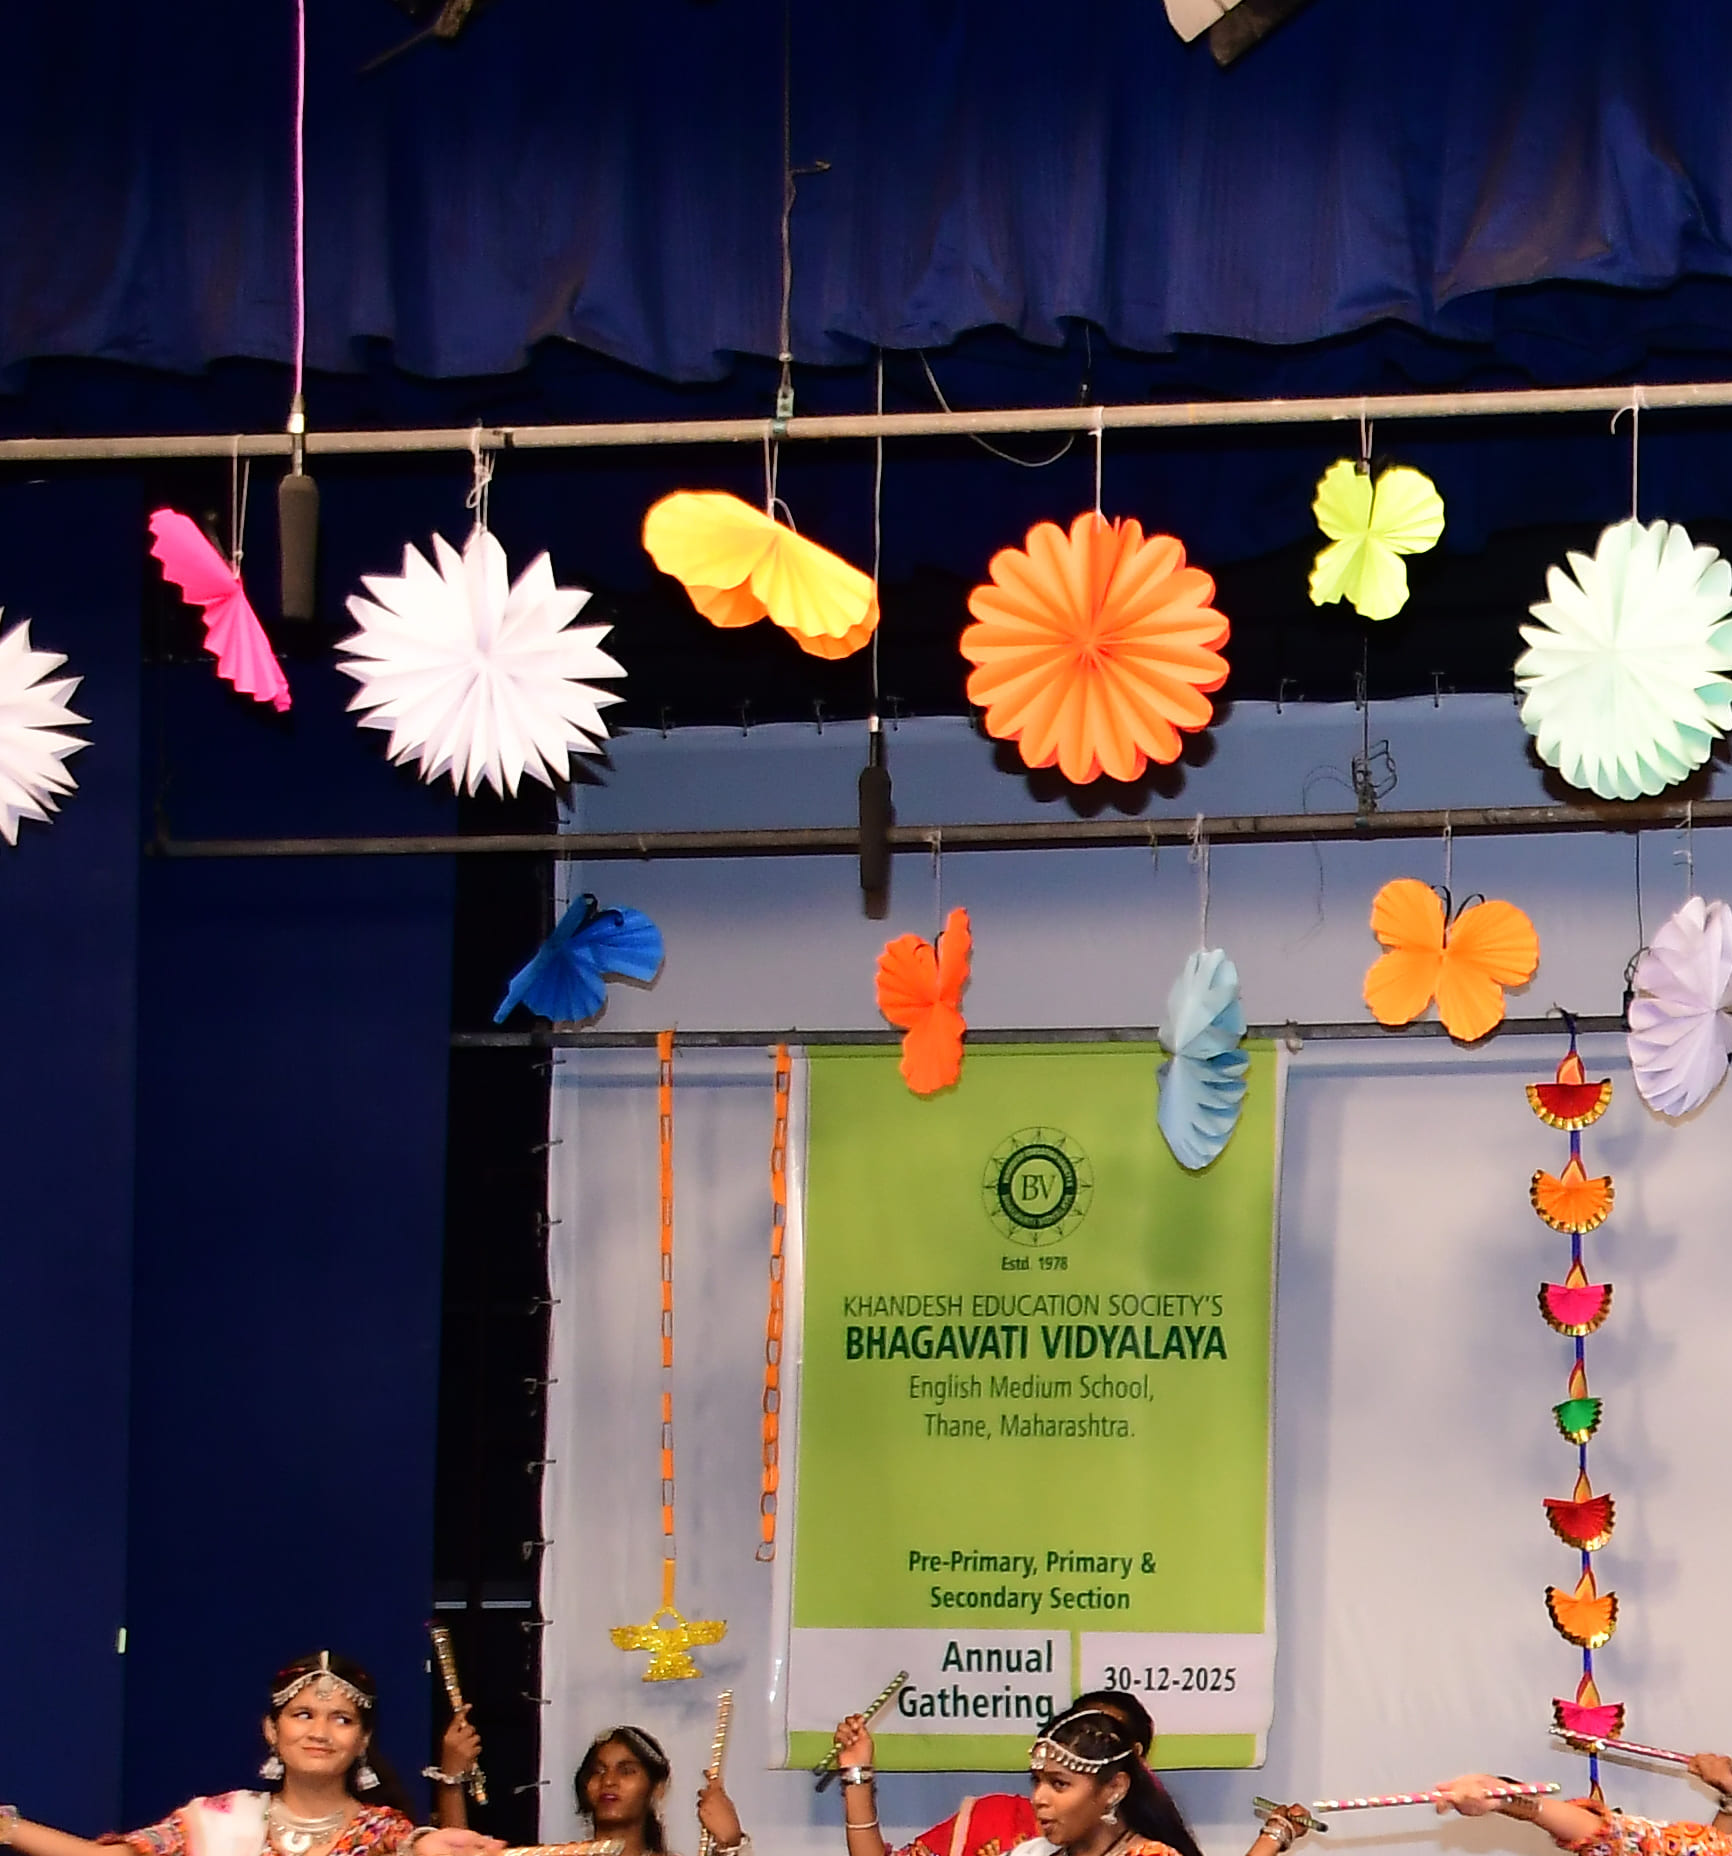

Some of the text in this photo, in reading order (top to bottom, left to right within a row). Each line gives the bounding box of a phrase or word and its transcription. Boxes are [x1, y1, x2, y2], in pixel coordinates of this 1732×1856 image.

[1021, 1174, 1057, 1201] BV
[844, 1295, 962, 1317] KHANDESH
[972, 1295, 1099, 1317] EDUCATION
[846, 1325, 1228, 1360] BHAGAVATI VIDYALAYA
[909, 1374, 1155, 1405] English Medium School,
[924, 1414, 1136, 1440] Thane, Maharashtra.
[909, 1551, 1156, 1579] Pre-Primary, Primary &
[931, 1587, 1130, 1614] Secondary Section
[942, 1640, 1053, 1673] Annual
[1104, 1666, 1237, 1692] 30-12-2025
[898, 1685, 1055, 1726] Gathering
